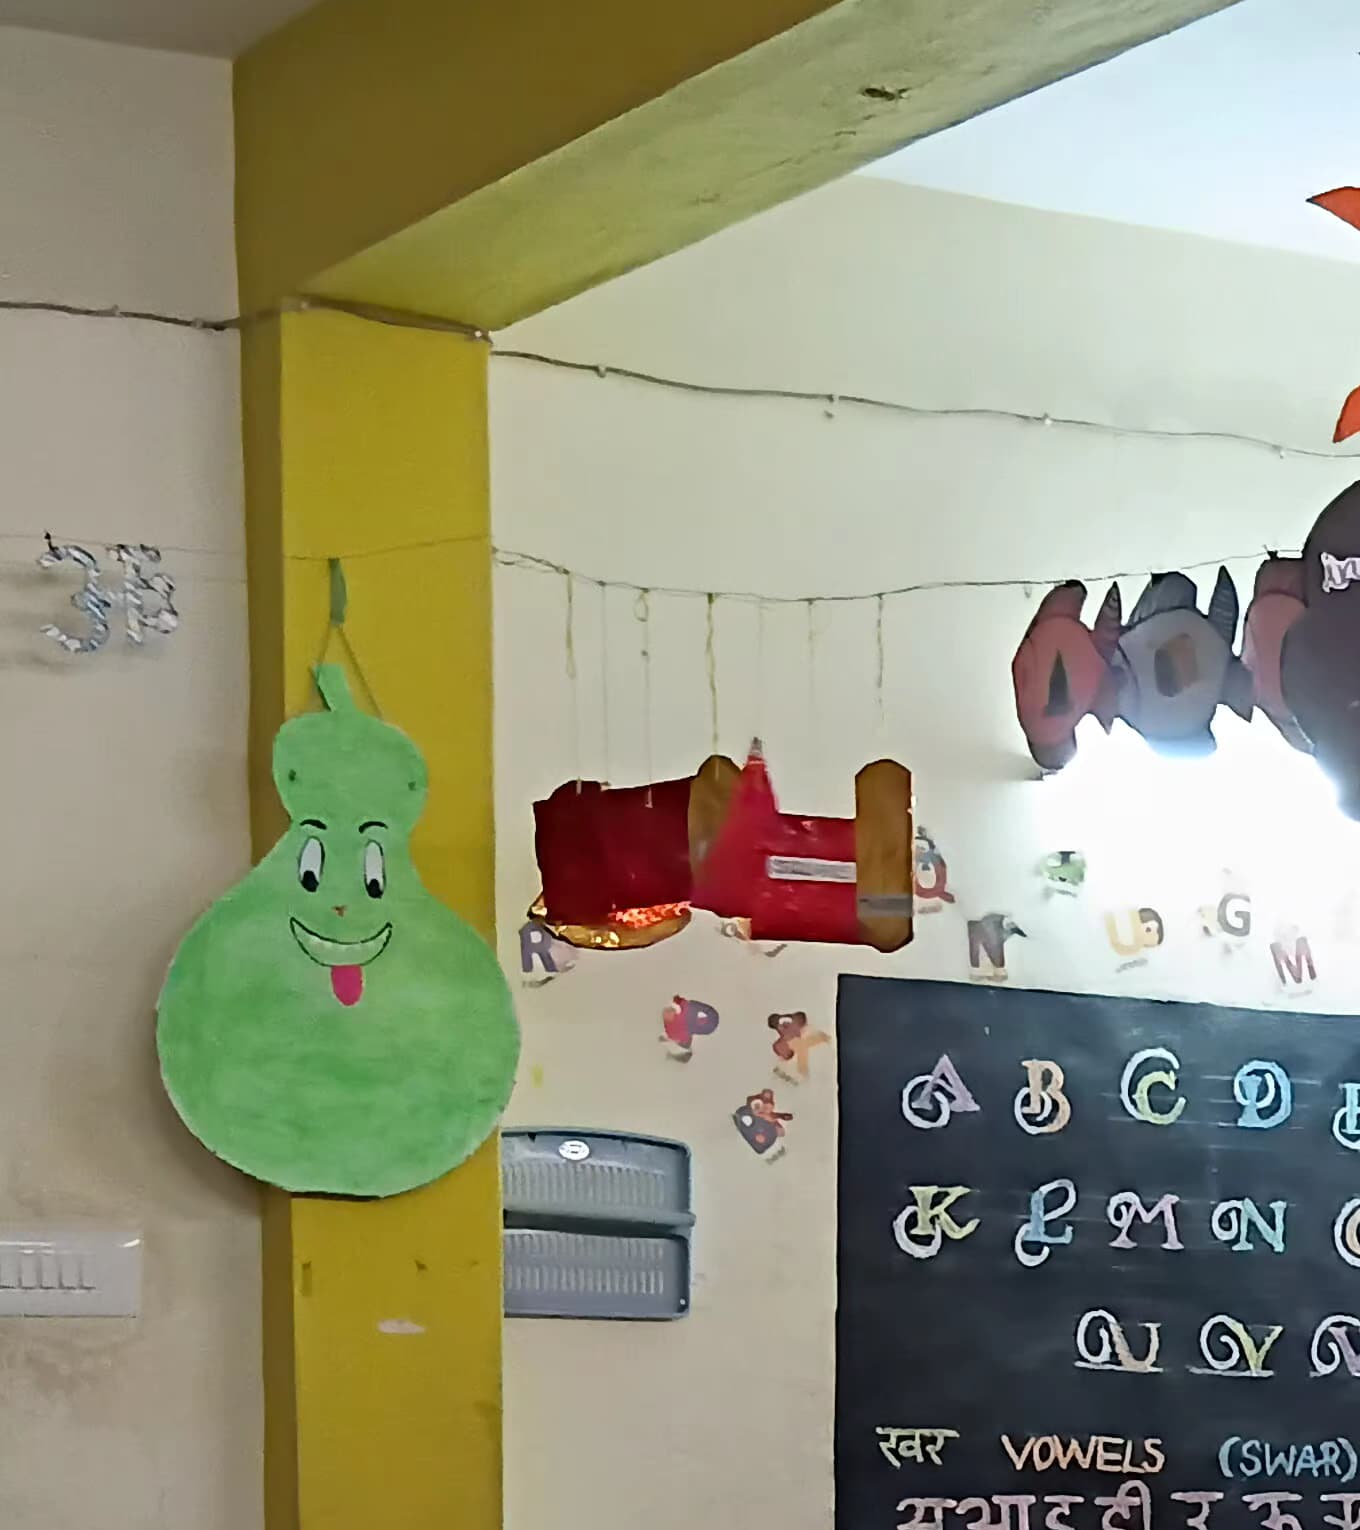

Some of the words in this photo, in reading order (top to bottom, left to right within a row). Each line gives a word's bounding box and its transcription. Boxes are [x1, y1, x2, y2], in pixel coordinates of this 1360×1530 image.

[1217, 893, 1250, 936] G
[519, 918, 558, 972] R
[1270, 937, 1317, 985] M
[903, 1054, 980, 1128] A
[1014, 1060, 1071, 1134] B
[1121, 1047, 1186, 1124] C
[1234, 1059, 1292, 1128] D
[893, 1186, 980, 1258] K
[1015, 1179, 1076, 1266] L
[1108, 1191, 1184, 1250] M
[1211, 1198, 1286, 1252] N
[1075, 1310, 1163, 1373] U
[1189, 1316, 1283, 1377] V
[1001, 1434, 1165, 1473] VOWELS
[1218, 1436, 1358, 1483] (SWAR)
